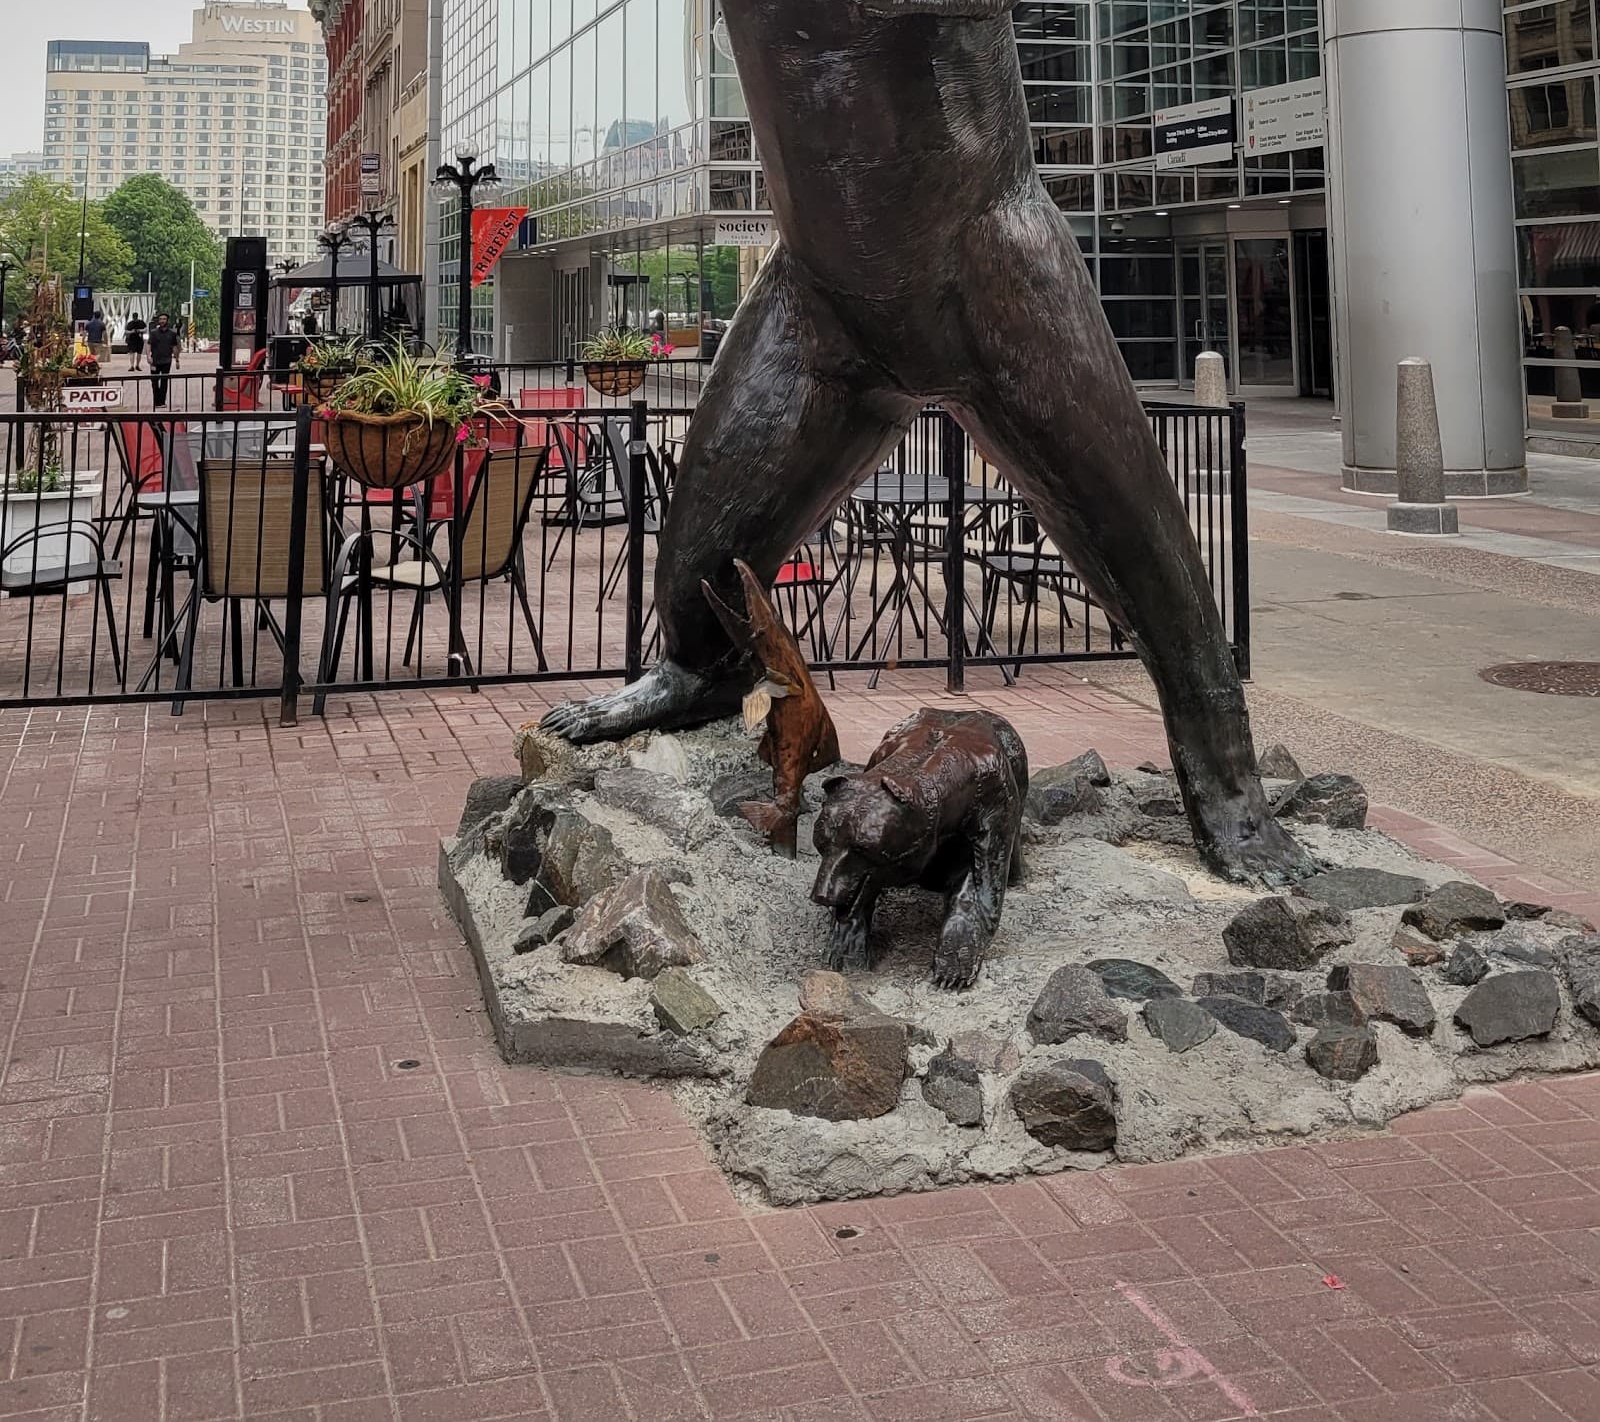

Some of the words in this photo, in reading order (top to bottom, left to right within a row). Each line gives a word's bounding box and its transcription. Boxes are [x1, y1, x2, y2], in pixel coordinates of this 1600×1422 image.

[220, 15, 295, 34] WESTIN
[719, 219, 768, 236] society
[475, 210, 520, 273] RIBFEST
[69, 390, 118, 402] PATIO
